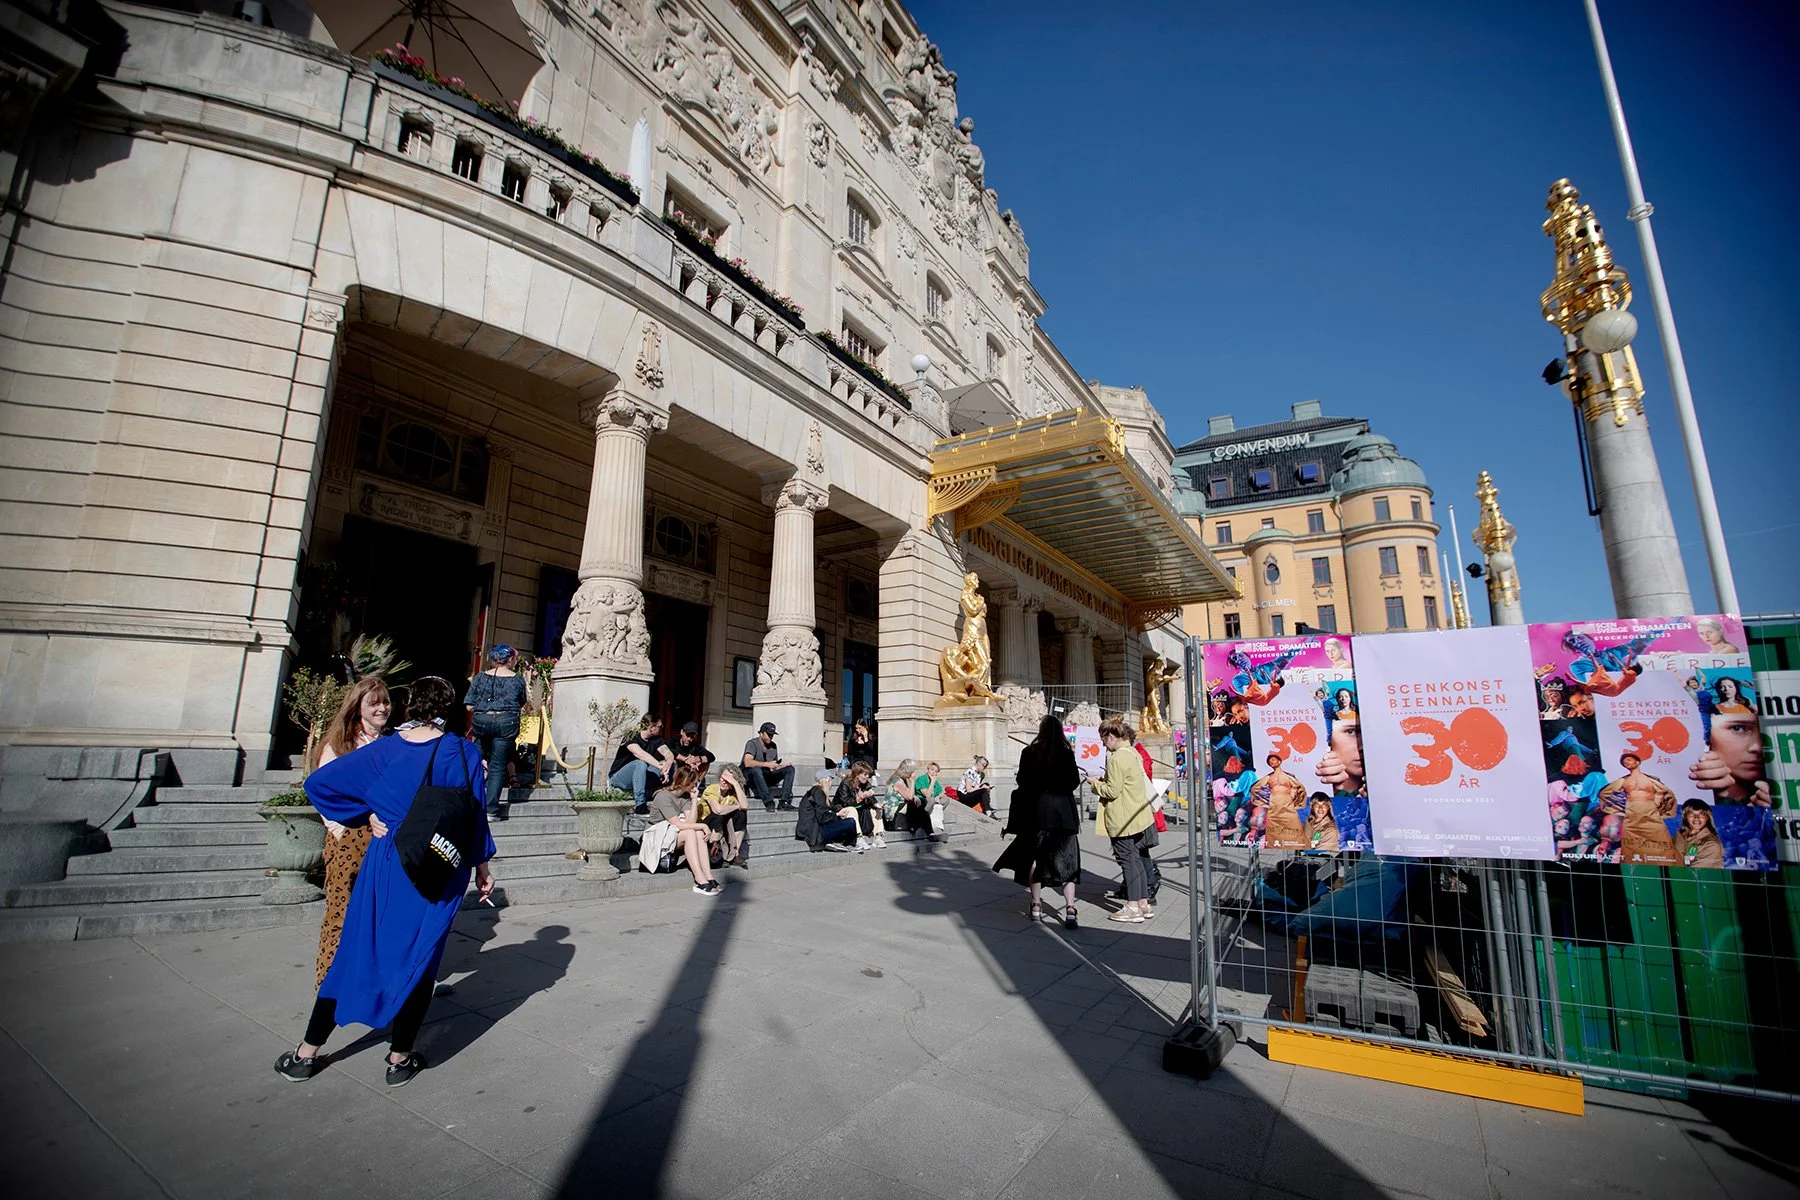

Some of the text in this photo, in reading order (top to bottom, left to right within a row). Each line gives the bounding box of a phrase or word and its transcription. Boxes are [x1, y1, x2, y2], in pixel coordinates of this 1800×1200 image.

[1214, 432, 1310, 457] CONVENDUM
[967, 526, 1034, 577] KUNGLIGA
[1632, 622, 1692, 633] DRAMATEN
[1594, 634, 1647, 642] STOCKHOLM
[1278, 642, 1322, 651] DRAMATEN
[1250, 651, 1289, 659] STOCKHOLM
[1387, 679, 1503, 695] SCENKONST
[1389, 693, 1506, 709] BIENNALEN
[1610, 700, 1686, 709] SCENKONST
[1260, 708, 1316, 716] SCENKONST
[1611, 708, 1689, 717] BIENNALEN
[1261, 715, 1317, 723] BIENNALEN
[1265, 721, 1317, 761] 30
[1618, 716, 1690, 761] 30
[1081, 743, 1100, 760] 30
[1399, 706, 1509, 787] 30
[1293, 755, 1304, 763] ÅR
[1656, 755, 1672, 764] ÅR
[1458, 774, 1480, 788] ÅR
[1435, 833, 1550, 842] DRAMATEN KULTURRÅDET
[430, 832, 458, 861] BACKA
[1562, 852, 1625, 861] KULTURRÅDET
